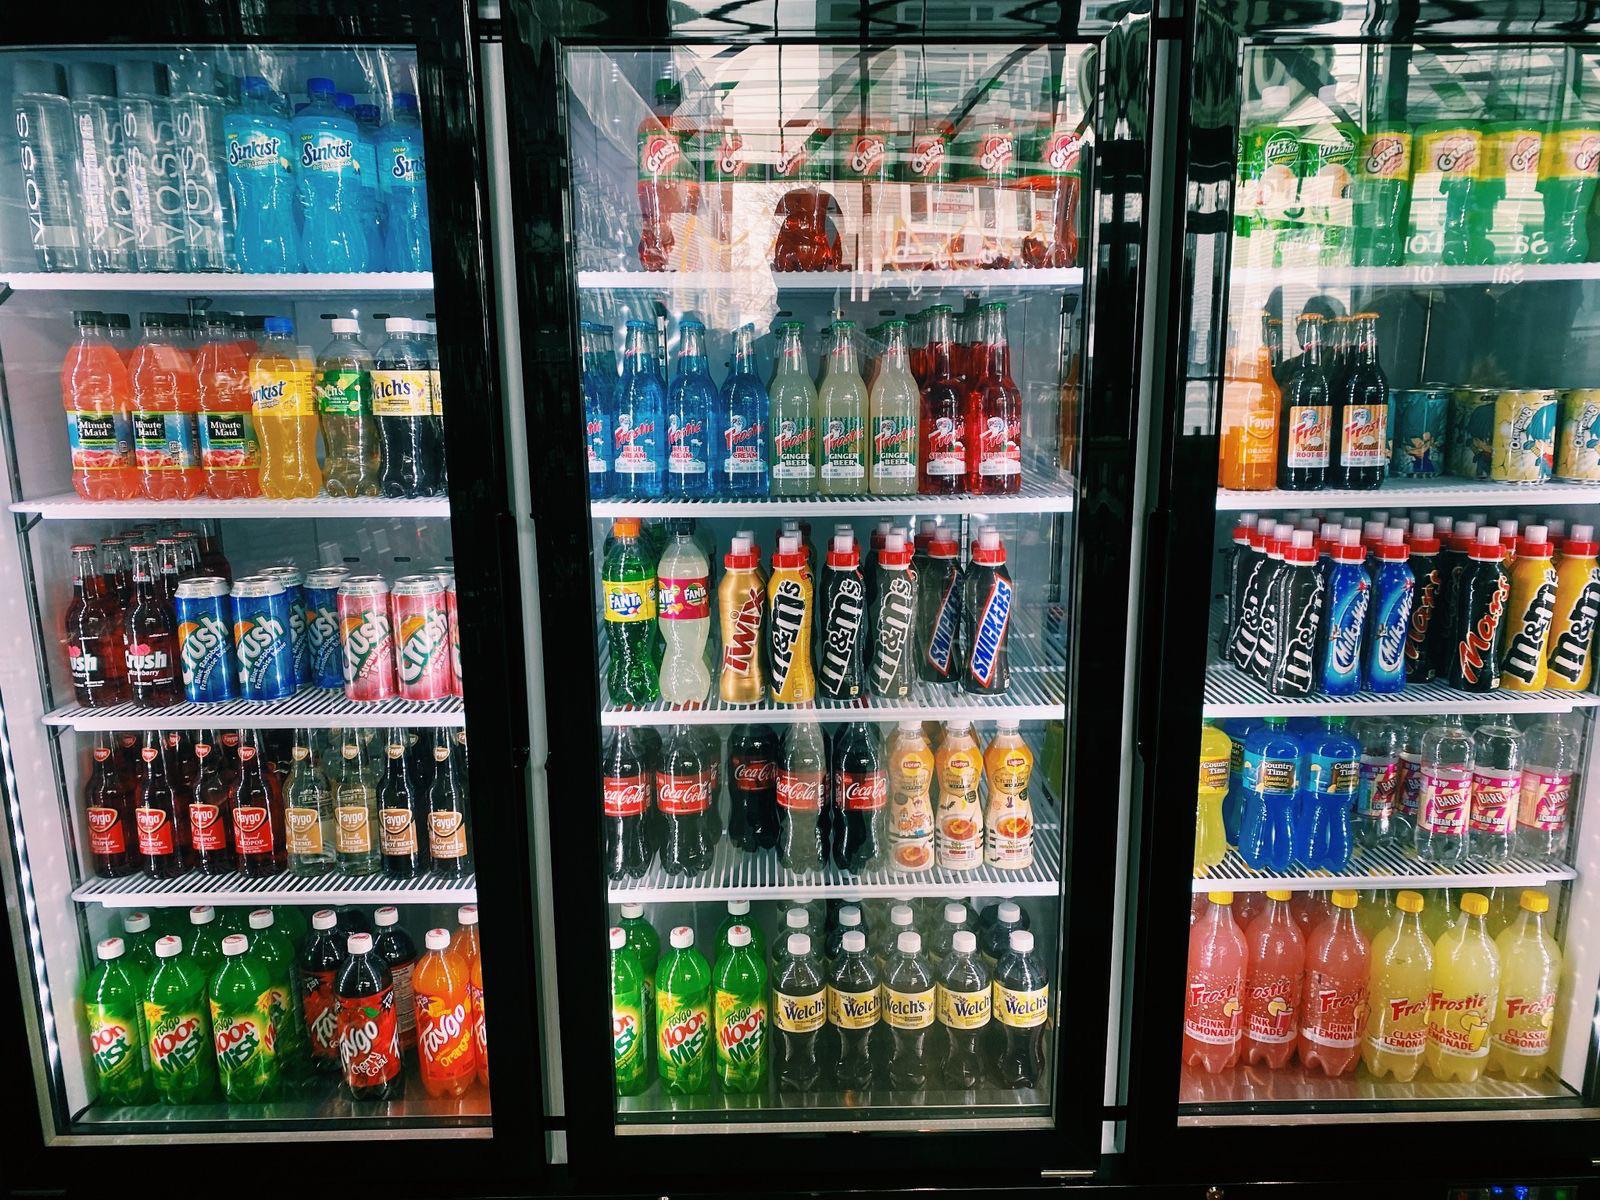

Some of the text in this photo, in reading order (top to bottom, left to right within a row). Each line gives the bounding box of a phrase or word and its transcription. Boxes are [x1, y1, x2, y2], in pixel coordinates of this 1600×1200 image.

[229, 137, 280, 166] Sunkist
[301, 140, 351, 167] Sunkist
[851, 141, 885, 173] Crush
[911, 141, 945, 173] Crush
[980, 137, 1013, 170] Crush
[1365, 139, 1404, 174] Crush
[392, 155, 425, 179] Sunk
[374, 380, 411, 399] elch's
[80, 421, 112, 429] Minute
[210, 421, 241, 429] Minute
[609, 592, 642, 609] FANTA
[684, 586, 706, 600] FANTA
[973, 580, 1012, 679] SNICKERS
[1460, 575, 1511, 684] Mars
[400, 610, 449, 683] Crush
[255, 657, 273, 689] Framboise
[1262, 761, 1293, 772] Country
[1436, 794, 1464, 807] BARR
[1478, 793, 1505, 804] BARR
[88, 812, 111, 825] Faygo
[138, 812, 160, 825] Faygo
[191, 808, 213, 821] Faygo
[237, 811, 260, 824] Faygo
[288, 811, 312, 825] Faygo
[340, 811, 363, 824] Faygo
[383, 812, 407, 826] Faygo
[432, 815, 457, 829] Faygo
[1005, 995, 1047, 1015] Welch's
[1430, 989, 1488, 1012] Frostie
[156, 1016, 180, 1039] Faygo
[667, 1008, 692, 1031] Faygo
[725, 1006, 751, 1028] Faygo
[1201, 1019, 1225, 1029] PINK
[1250, 1015, 1269, 1027] INK
[420, 1004, 466, 1062] Faygo
[1187, 1020, 1238, 1037] LEMONADE
[1329, 1023, 1354, 1033] PINK
[160, 1028, 206, 1075] Mist
[440, 1030, 472, 1068] Orange
[670, 1022, 710, 1067] Mist
[727, 1019, 767, 1066] Mist
[351, 1051, 382, 1074] Cherry
